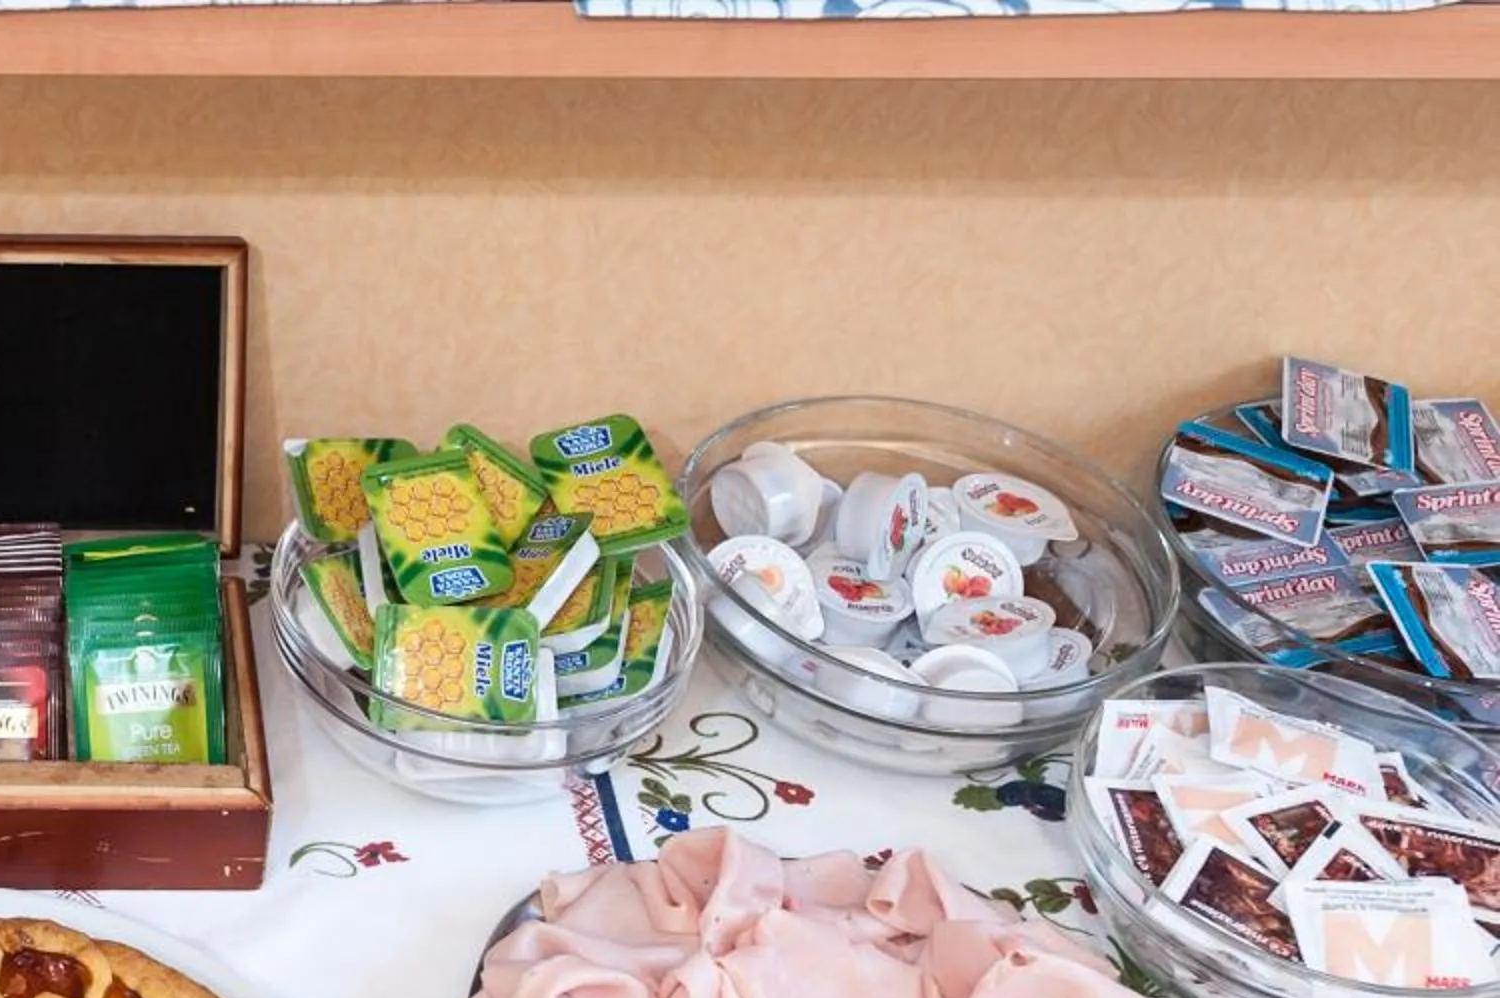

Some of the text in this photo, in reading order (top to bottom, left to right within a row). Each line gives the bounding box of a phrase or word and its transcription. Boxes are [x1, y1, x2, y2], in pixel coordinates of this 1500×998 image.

[571, 456, 621, 477] Miele
[422, 544, 470, 562] Miele
[476, 643, 491, 696] Miele
[106, 684, 192, 711] TWININGS
[131, 725, 172, 741] Pure
